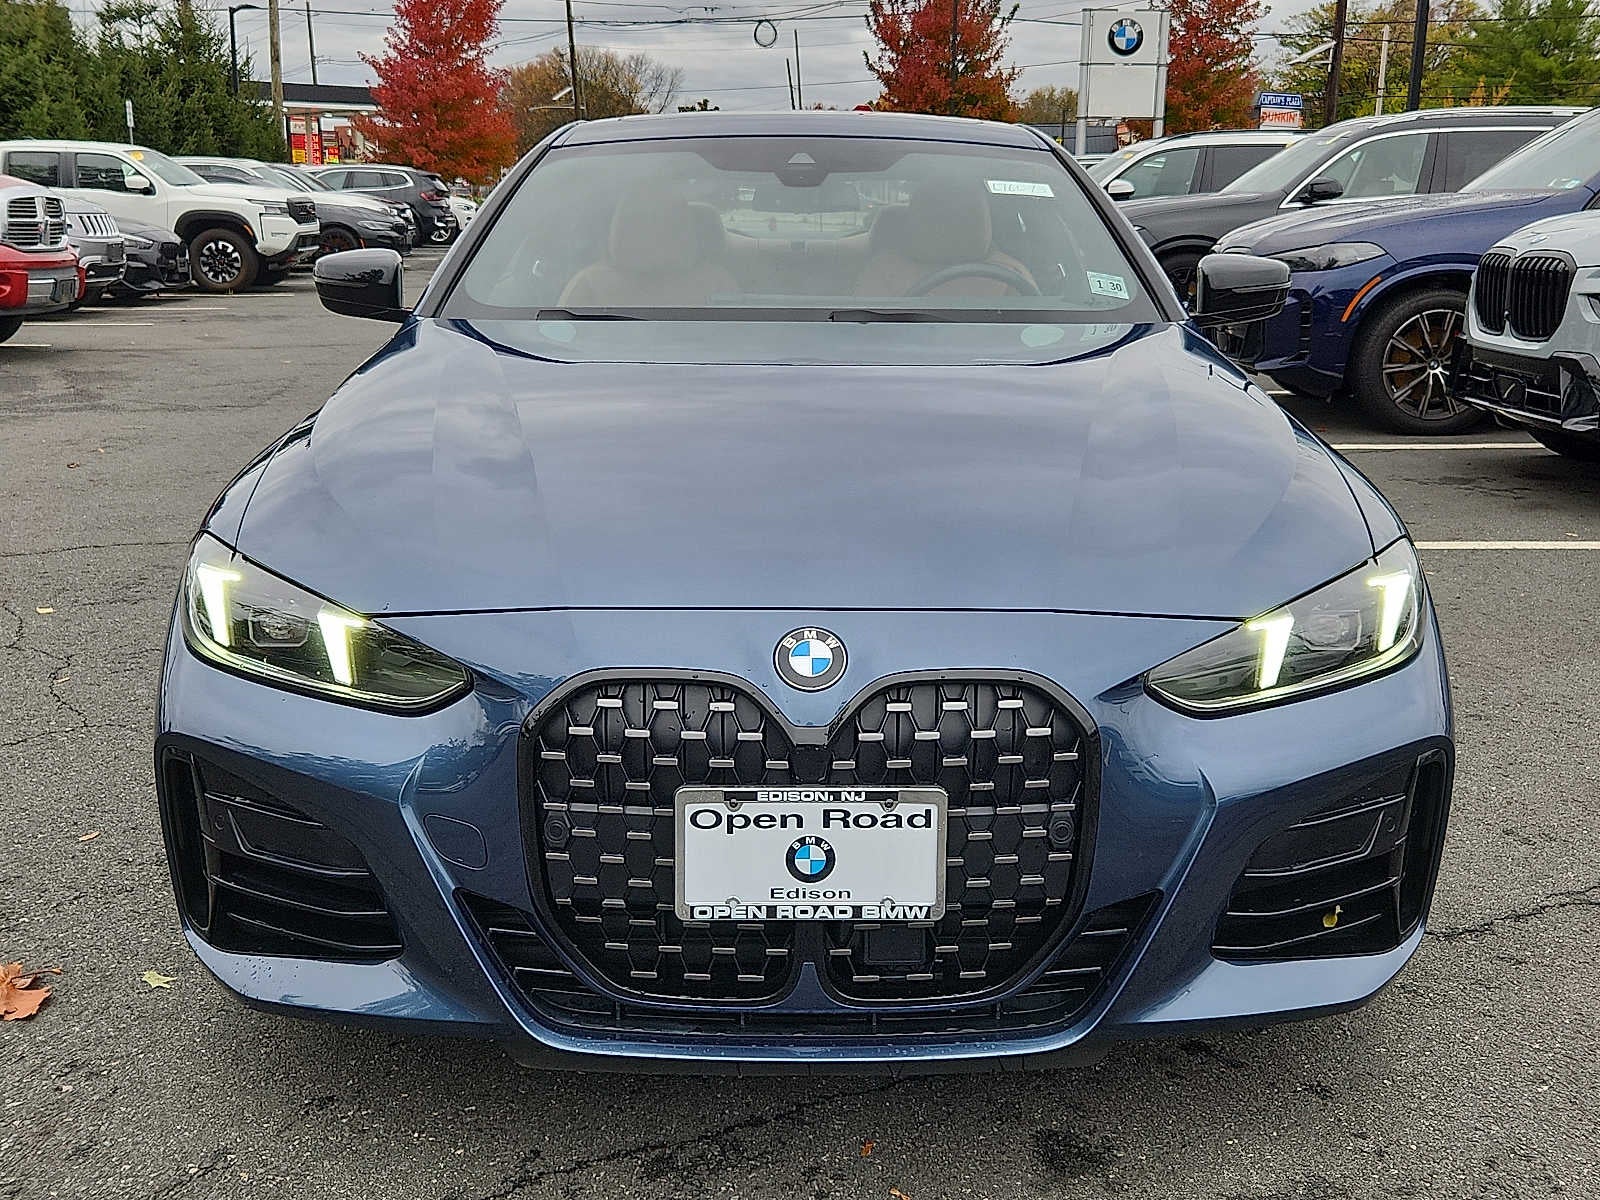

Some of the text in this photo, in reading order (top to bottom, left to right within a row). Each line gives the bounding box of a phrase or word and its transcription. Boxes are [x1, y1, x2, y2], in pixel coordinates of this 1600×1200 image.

[1261, 111, 1298, 123] DUNKIN'
[1096, 280, 1122, 292] 1 30
[783, 630, 840, 649] BMW
[840, 790, 867, 802] NJ
[689, 808, 933, 834] Open Road
[791, 836, 831, 851] BMW
[769, 887, 852, 900] Edison
[693, 905, 929, 920] OPEN ROAD BMW
